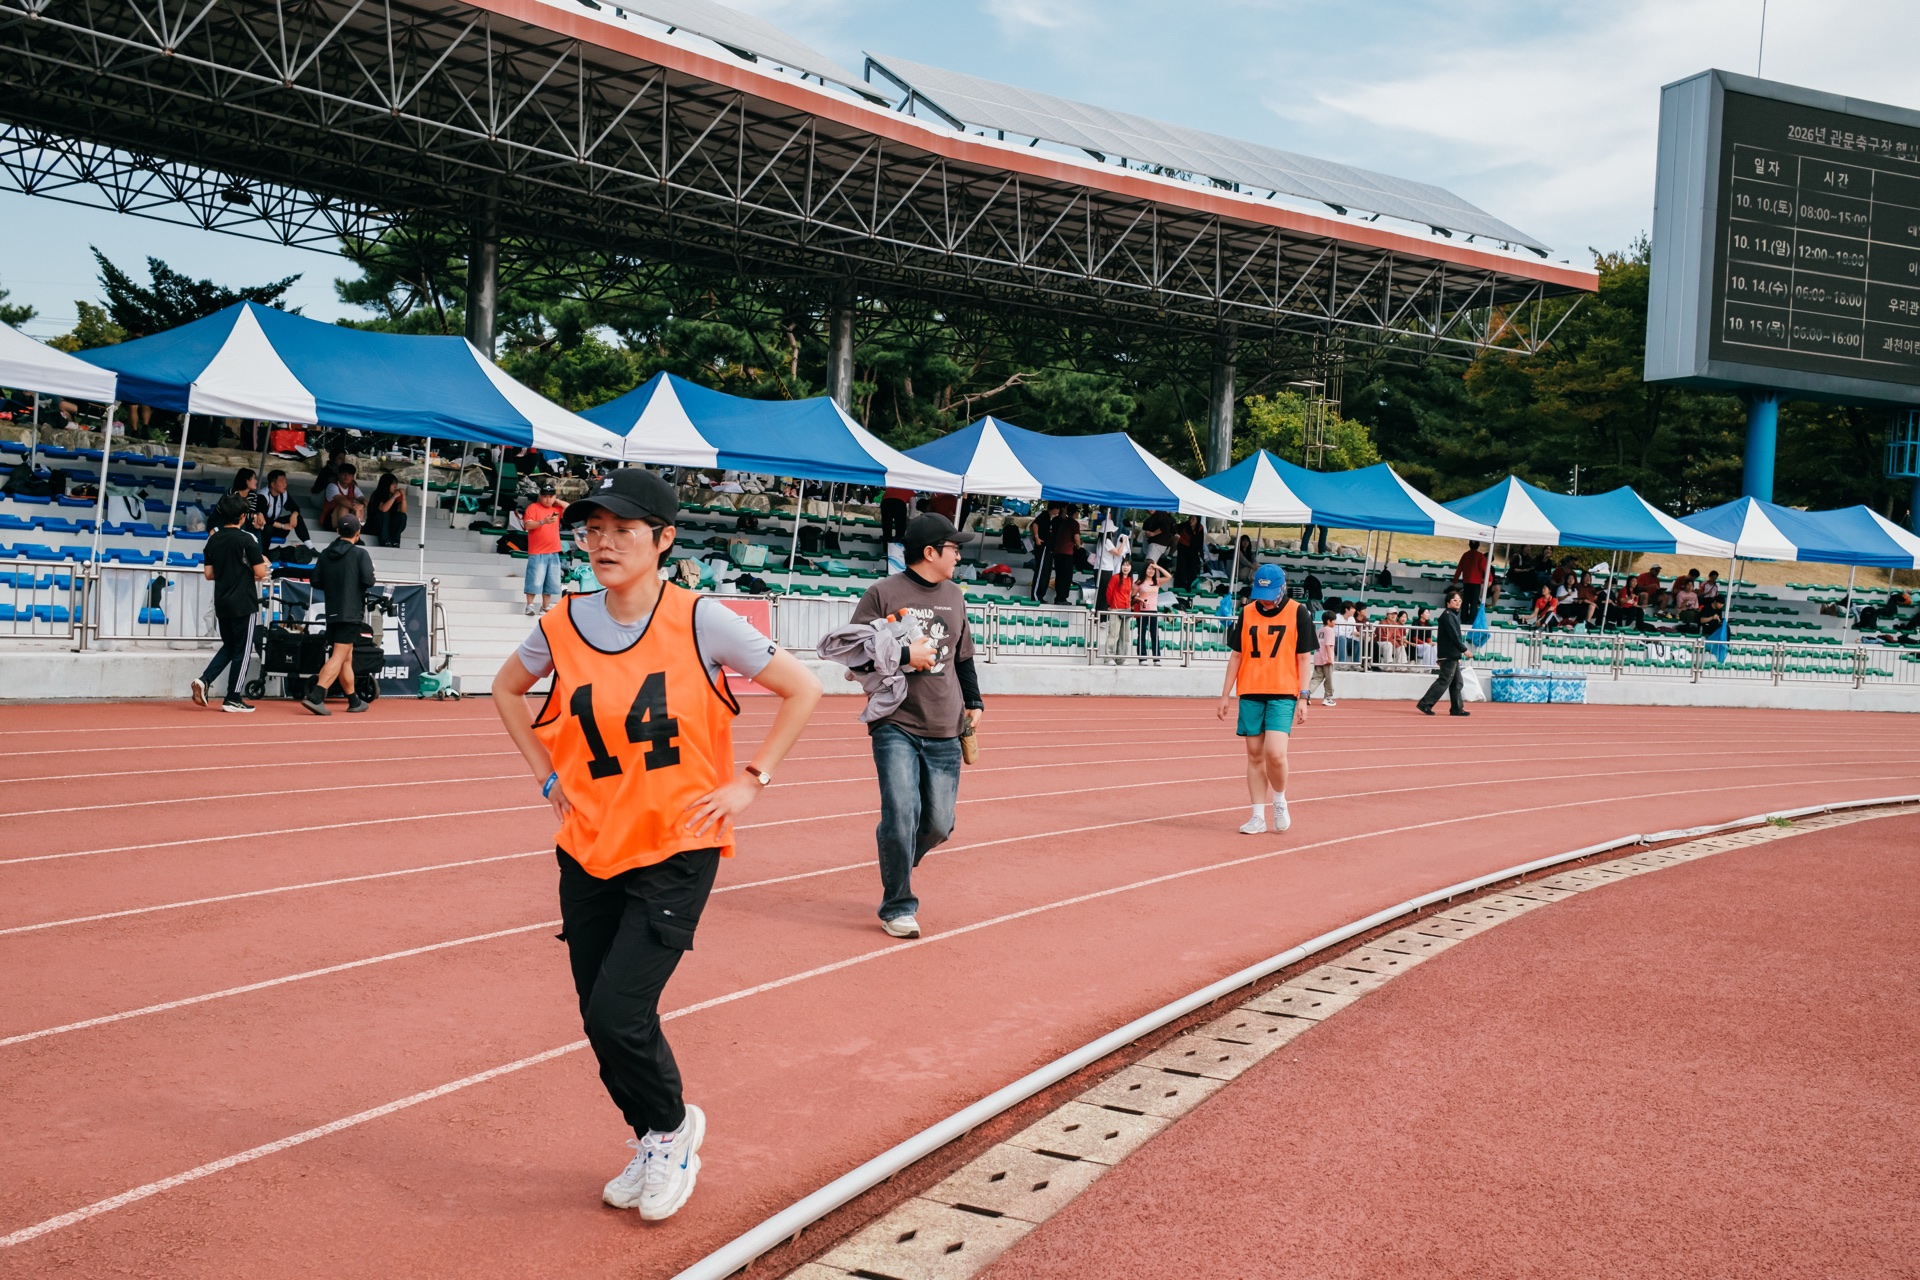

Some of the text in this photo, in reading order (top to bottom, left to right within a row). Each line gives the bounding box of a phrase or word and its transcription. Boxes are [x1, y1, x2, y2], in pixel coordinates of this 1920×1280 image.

[1788, 125, 1826, 144] 2026년
[1249, 625, 1287, 658] 17
[570, 670, 681, 780] 14
